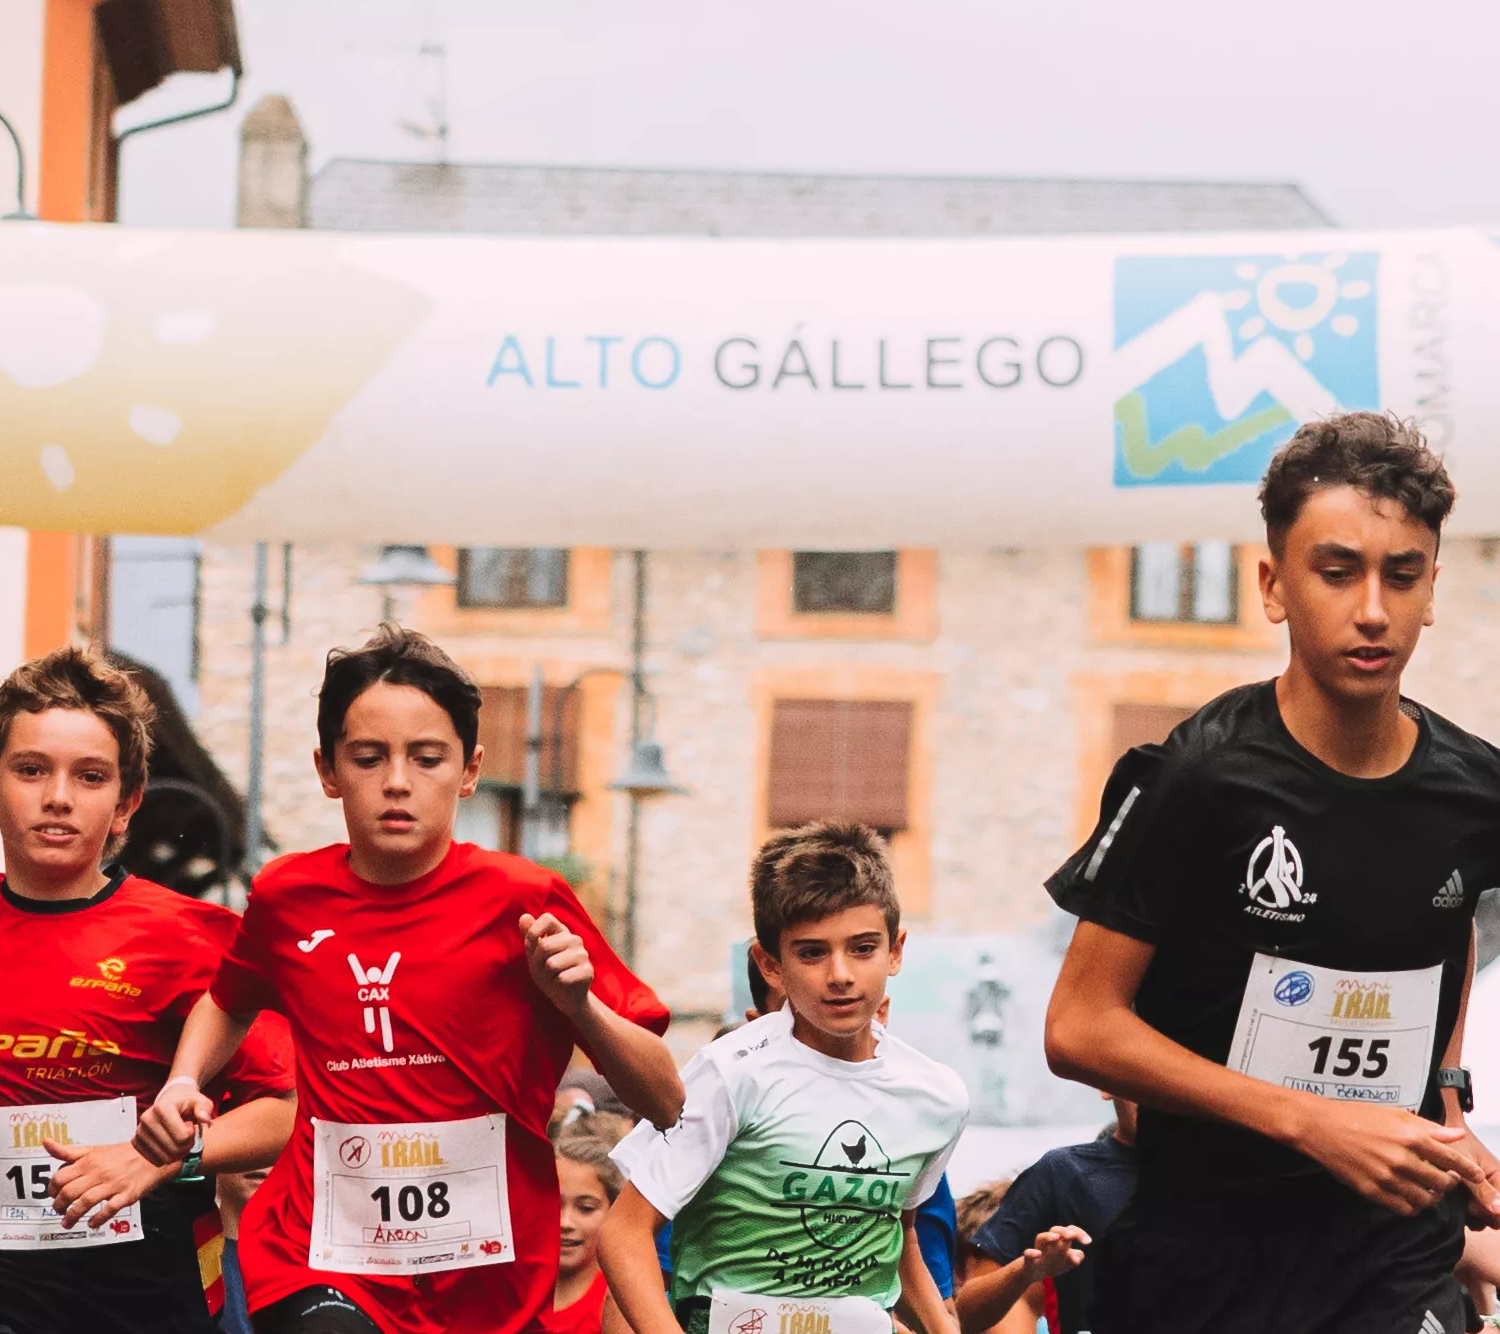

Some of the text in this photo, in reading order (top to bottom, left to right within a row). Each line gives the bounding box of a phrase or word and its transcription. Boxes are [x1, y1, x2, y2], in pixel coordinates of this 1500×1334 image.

[486, 322, 1087, 391] ALTO GÁLLEGO
[1244, 905, 1306, 923] ATLETISMO
[357, 987, 390, 1002] CAX
[1332, 989, 1391, 1018] TRAIL
[326, 1053, 446, 1072] Club Atletisme Xàtiva
[1308, 1035, 1391, 1079] 155
[11, 1121, 74, 1148] TRAIL
[379, 1139, 444, 1168] TRAIL
[5, 1160, 75, 1200] 15
[370, 1181, 451, 1222] 108
[373, 1224, 428, 1243] AARON
[779, 1312, 832, 1334] TRAIL
